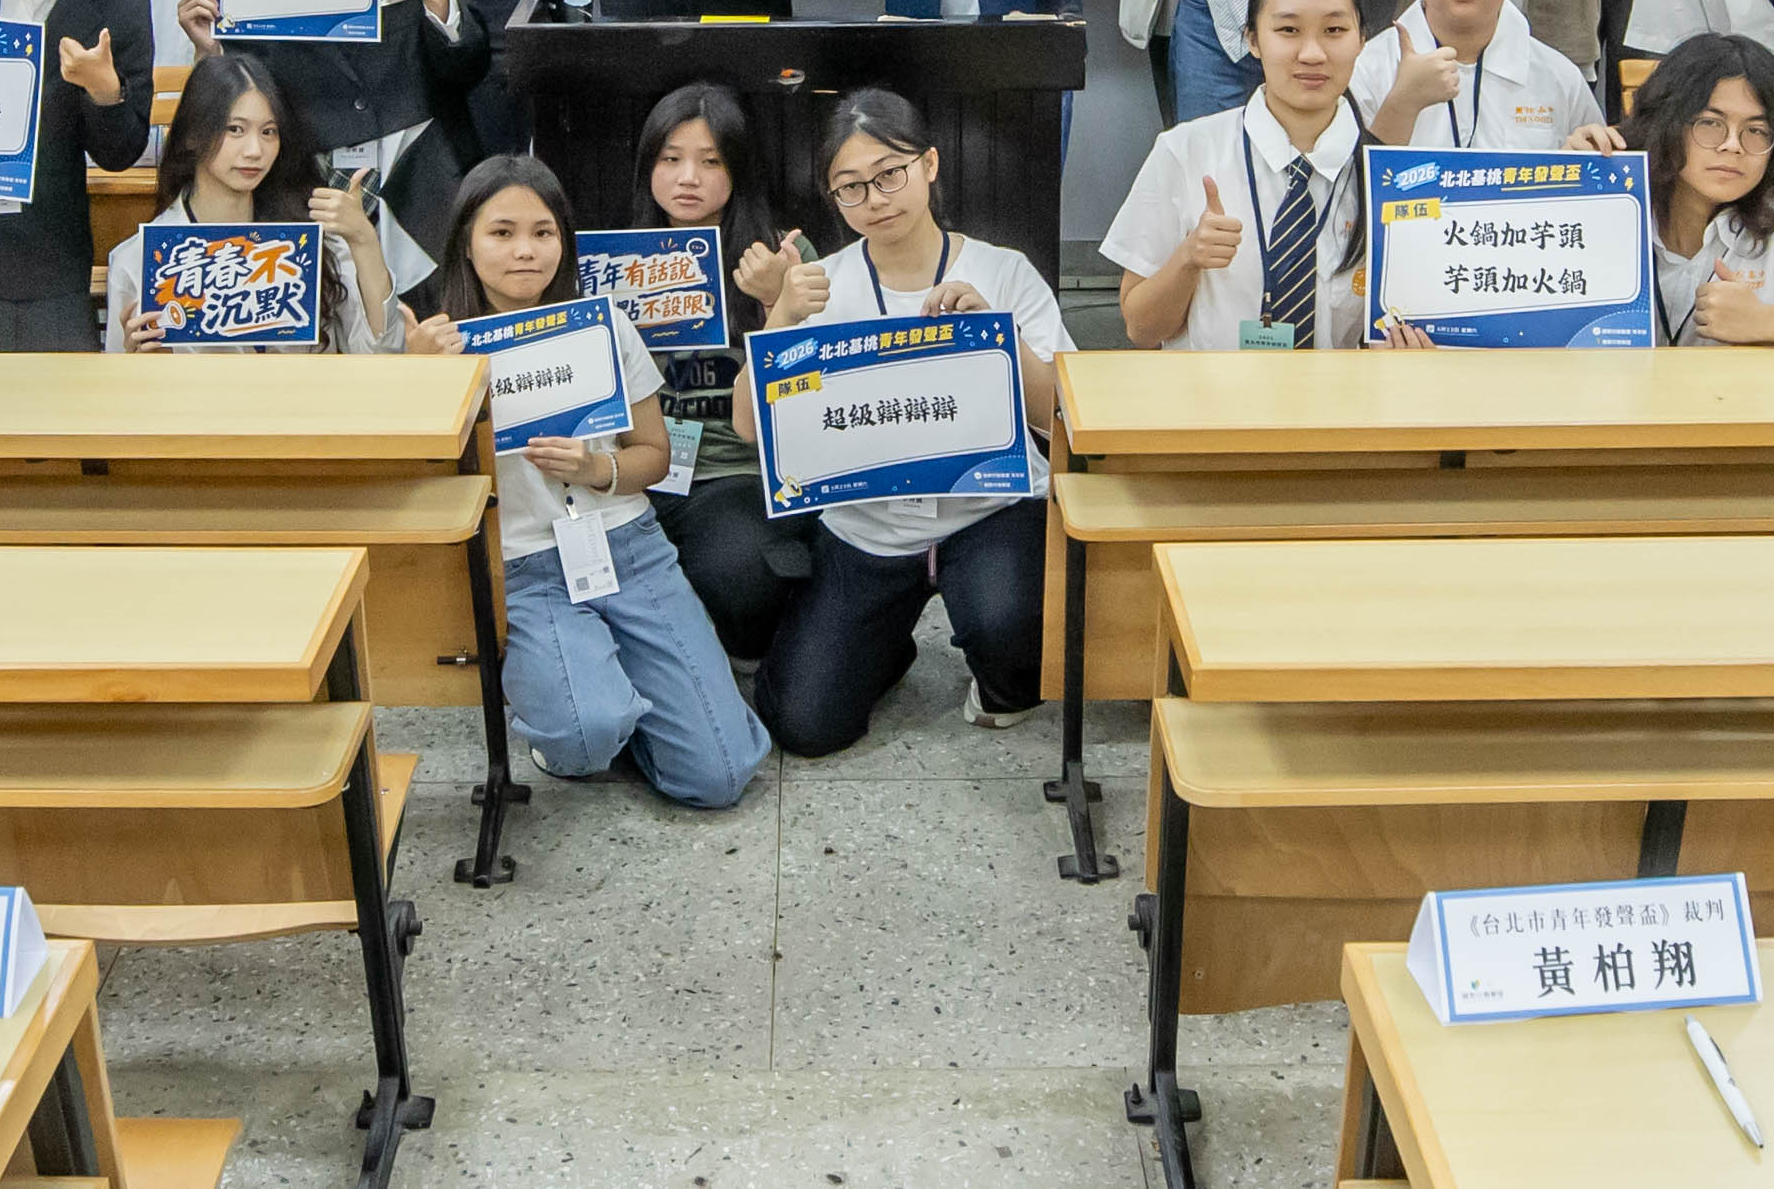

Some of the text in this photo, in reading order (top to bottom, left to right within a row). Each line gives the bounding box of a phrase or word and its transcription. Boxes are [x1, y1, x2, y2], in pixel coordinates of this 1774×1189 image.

[1399, 164, 1583, 189] 2026 北北基桃青年發聲盃
[1394, 203, 1429, 219] 隊伍
[1443, 219, 1586, 250] 火鍋加芋頭
[164, 242, 299, 298] 青春不
[1443, 263, 1588, 296] 芋頭加火鍋
[205, 282, 305, 328] 沉默
[780, 322, 955, 366] 2026 北北基桃青年發聲盃
[489, 363, 574, 399] 級辯辯辯
[777, 377, 811, 397] 隊伍
[821, 394, 959, 431] 超級辯辯辯
[1682, 898, 1725, 924] 裁判
[1532, 938, 1698, 999] 黃柏翔
